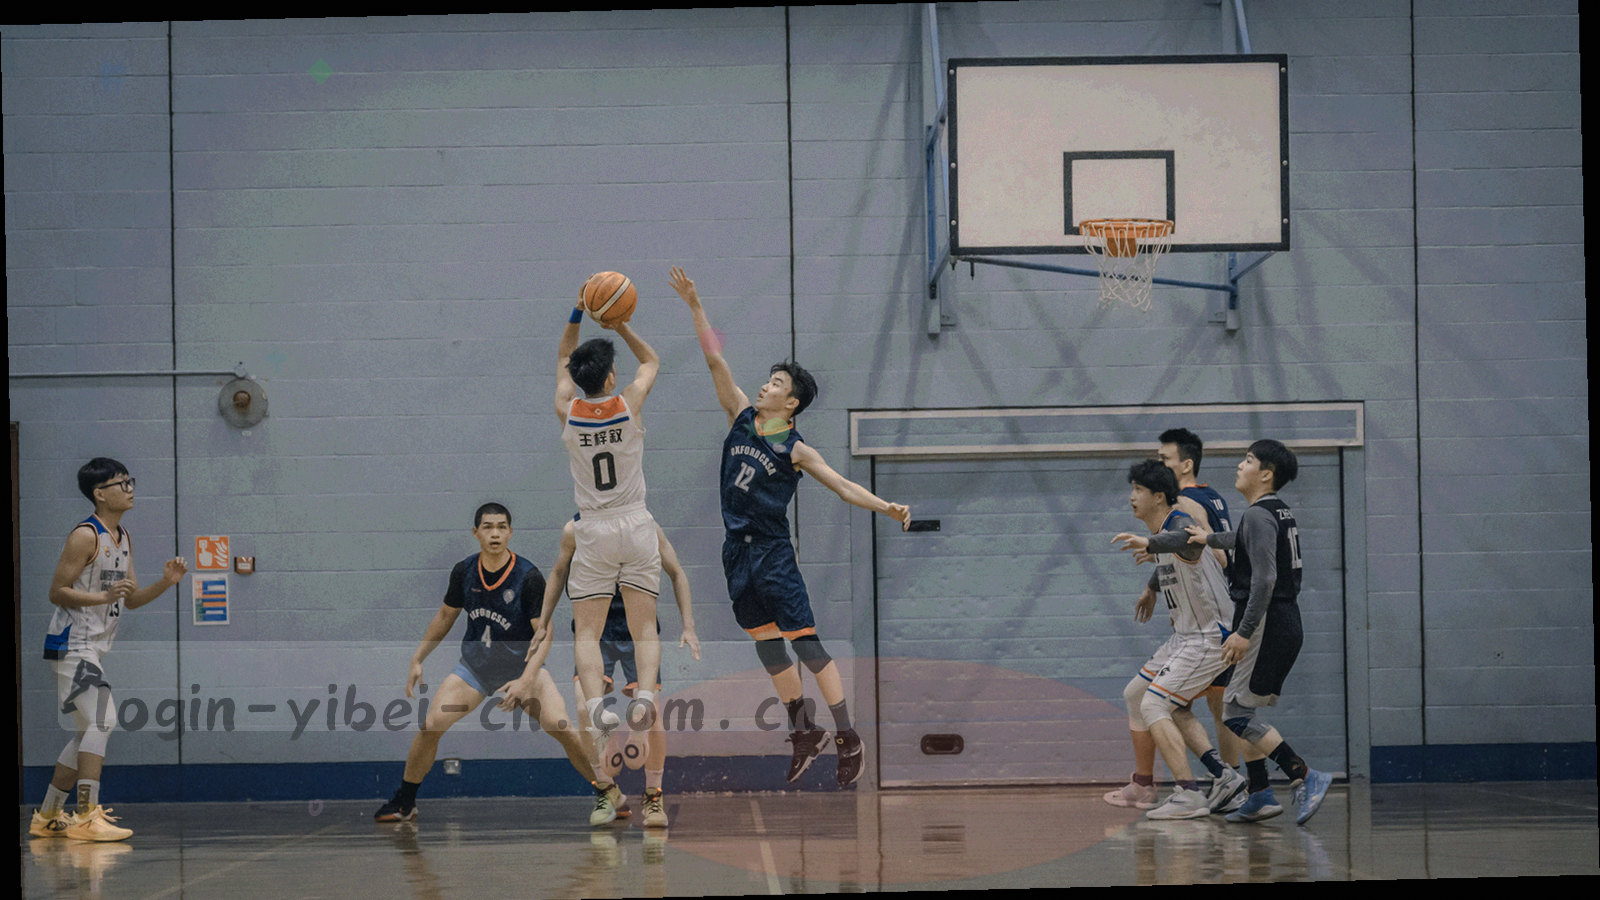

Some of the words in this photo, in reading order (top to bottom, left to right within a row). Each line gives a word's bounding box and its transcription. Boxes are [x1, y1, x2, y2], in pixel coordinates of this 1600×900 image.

[592, 451, 617, 492] 0
[734, 462, 756, 492] 12
[480, 625, 492, 649] 4
